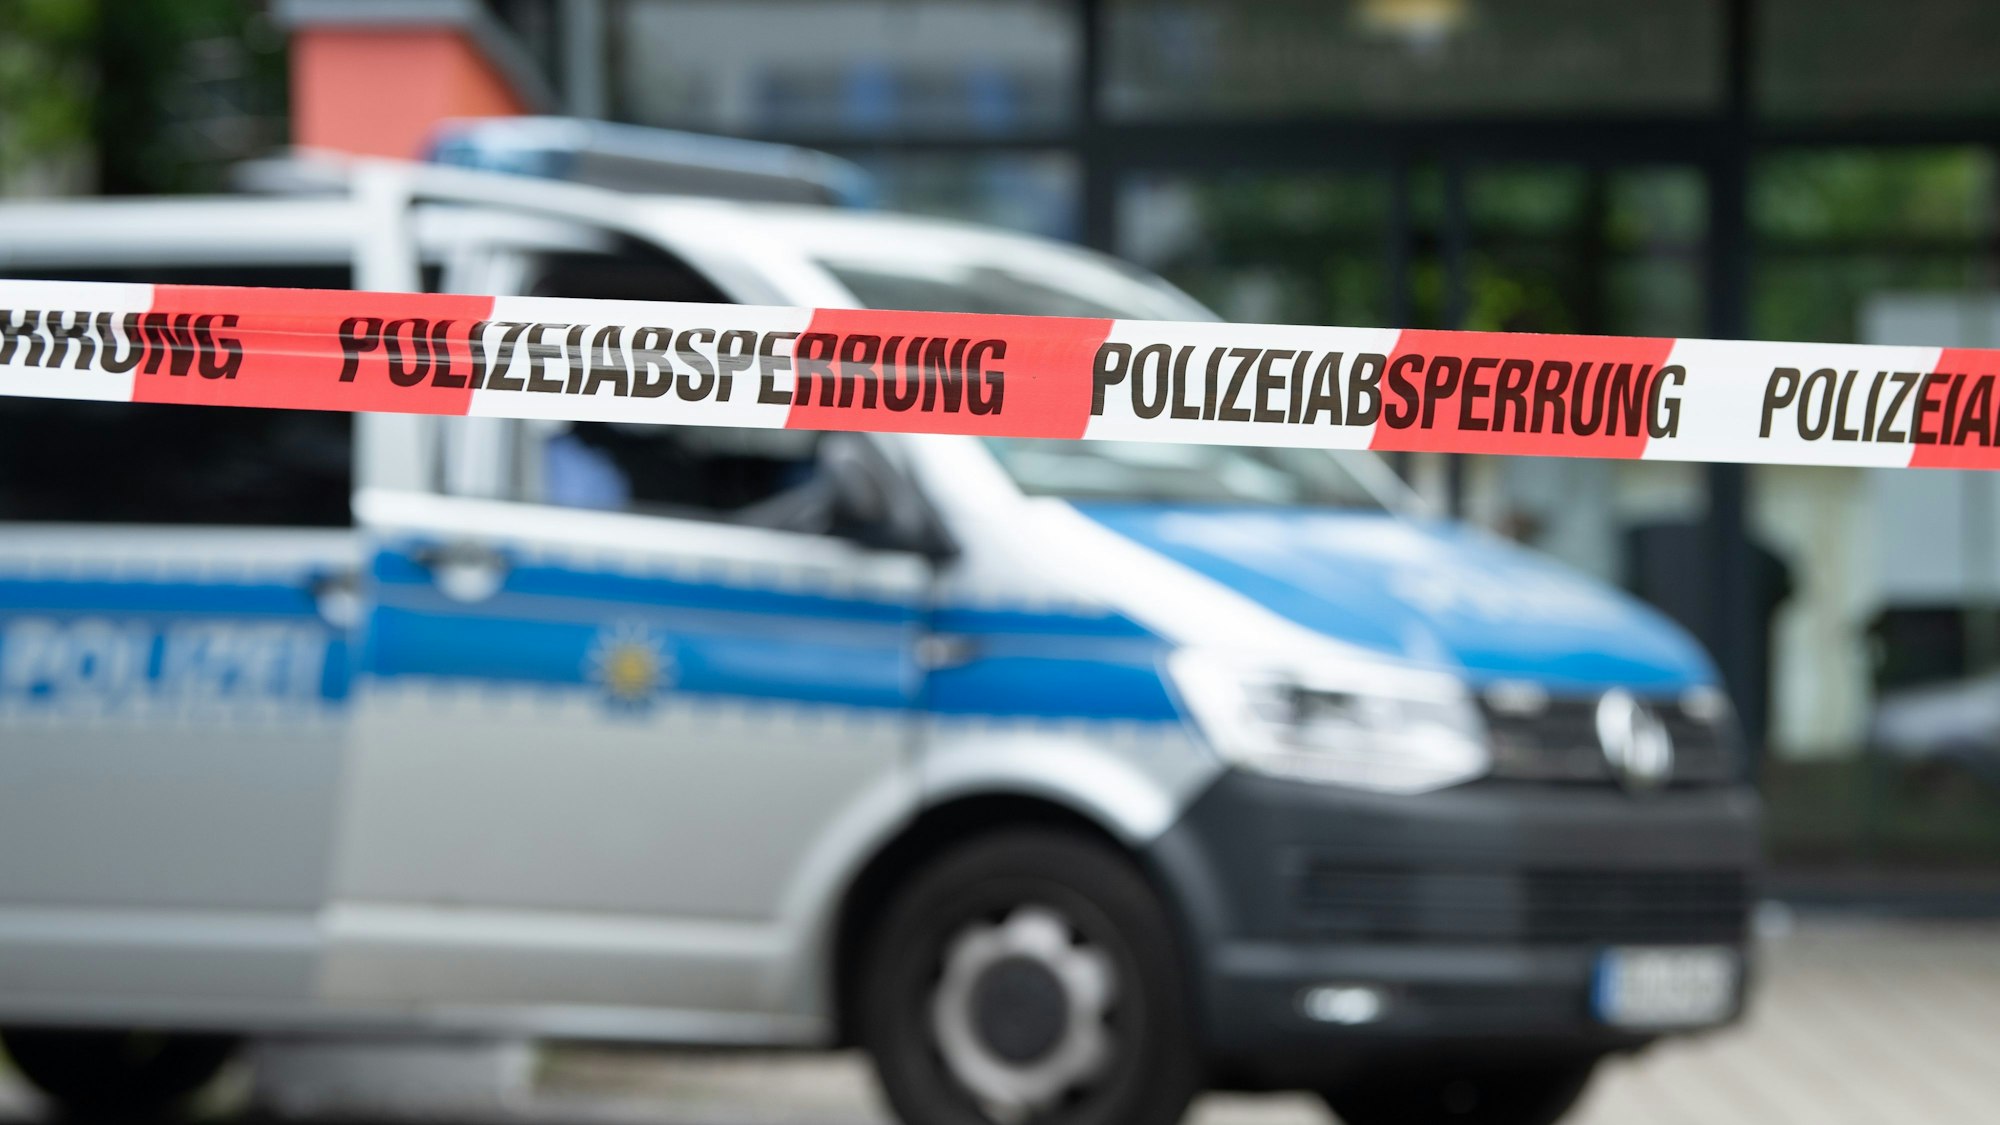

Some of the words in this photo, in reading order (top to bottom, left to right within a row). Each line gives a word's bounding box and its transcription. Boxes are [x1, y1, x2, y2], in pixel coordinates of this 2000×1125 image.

[339, 316, 1007, 416] POLIZEIABSPERRUNG
[1090, 342, 1687, 439] POLIZEIABSPERRUNG
[1759, 368, 2000, 448] POLIZEIA
